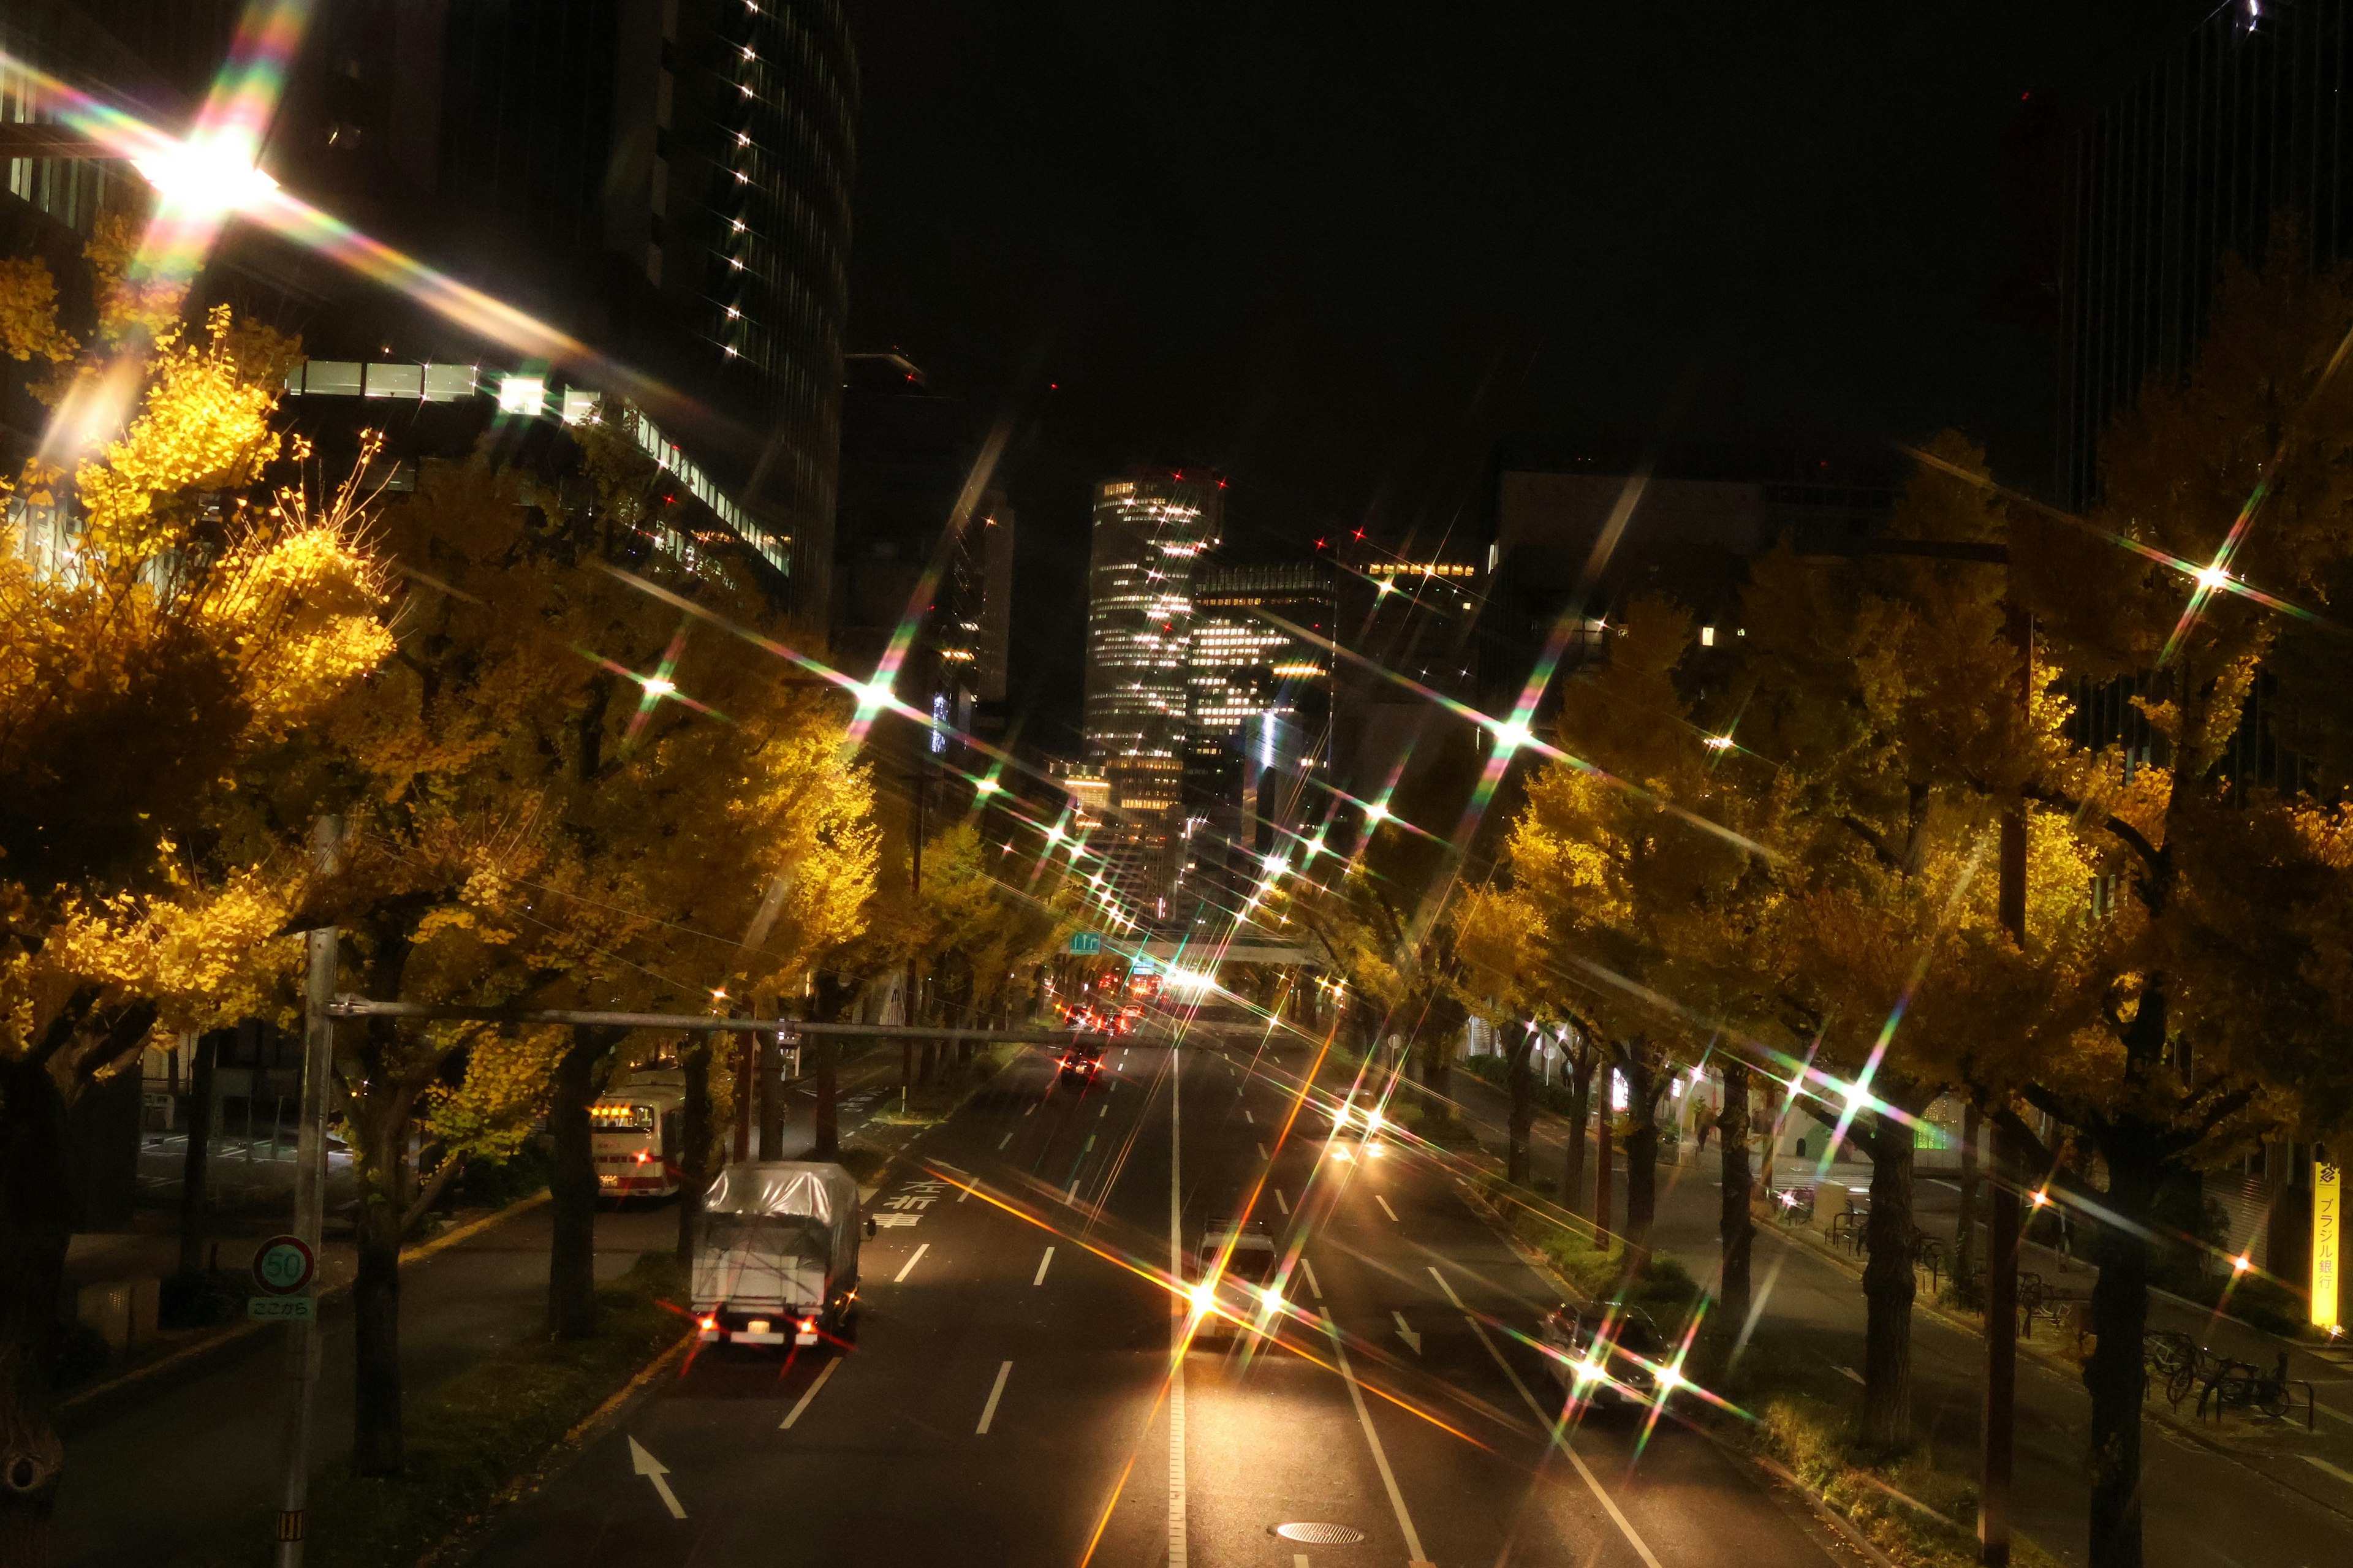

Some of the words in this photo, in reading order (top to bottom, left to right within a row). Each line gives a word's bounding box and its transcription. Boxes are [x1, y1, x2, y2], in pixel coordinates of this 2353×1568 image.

[2319, 1199, 2333, 1289] ブラジル銀行
[267, 1252, 300, 1278] 50
[254, 1303, 307, 1315] ここから
